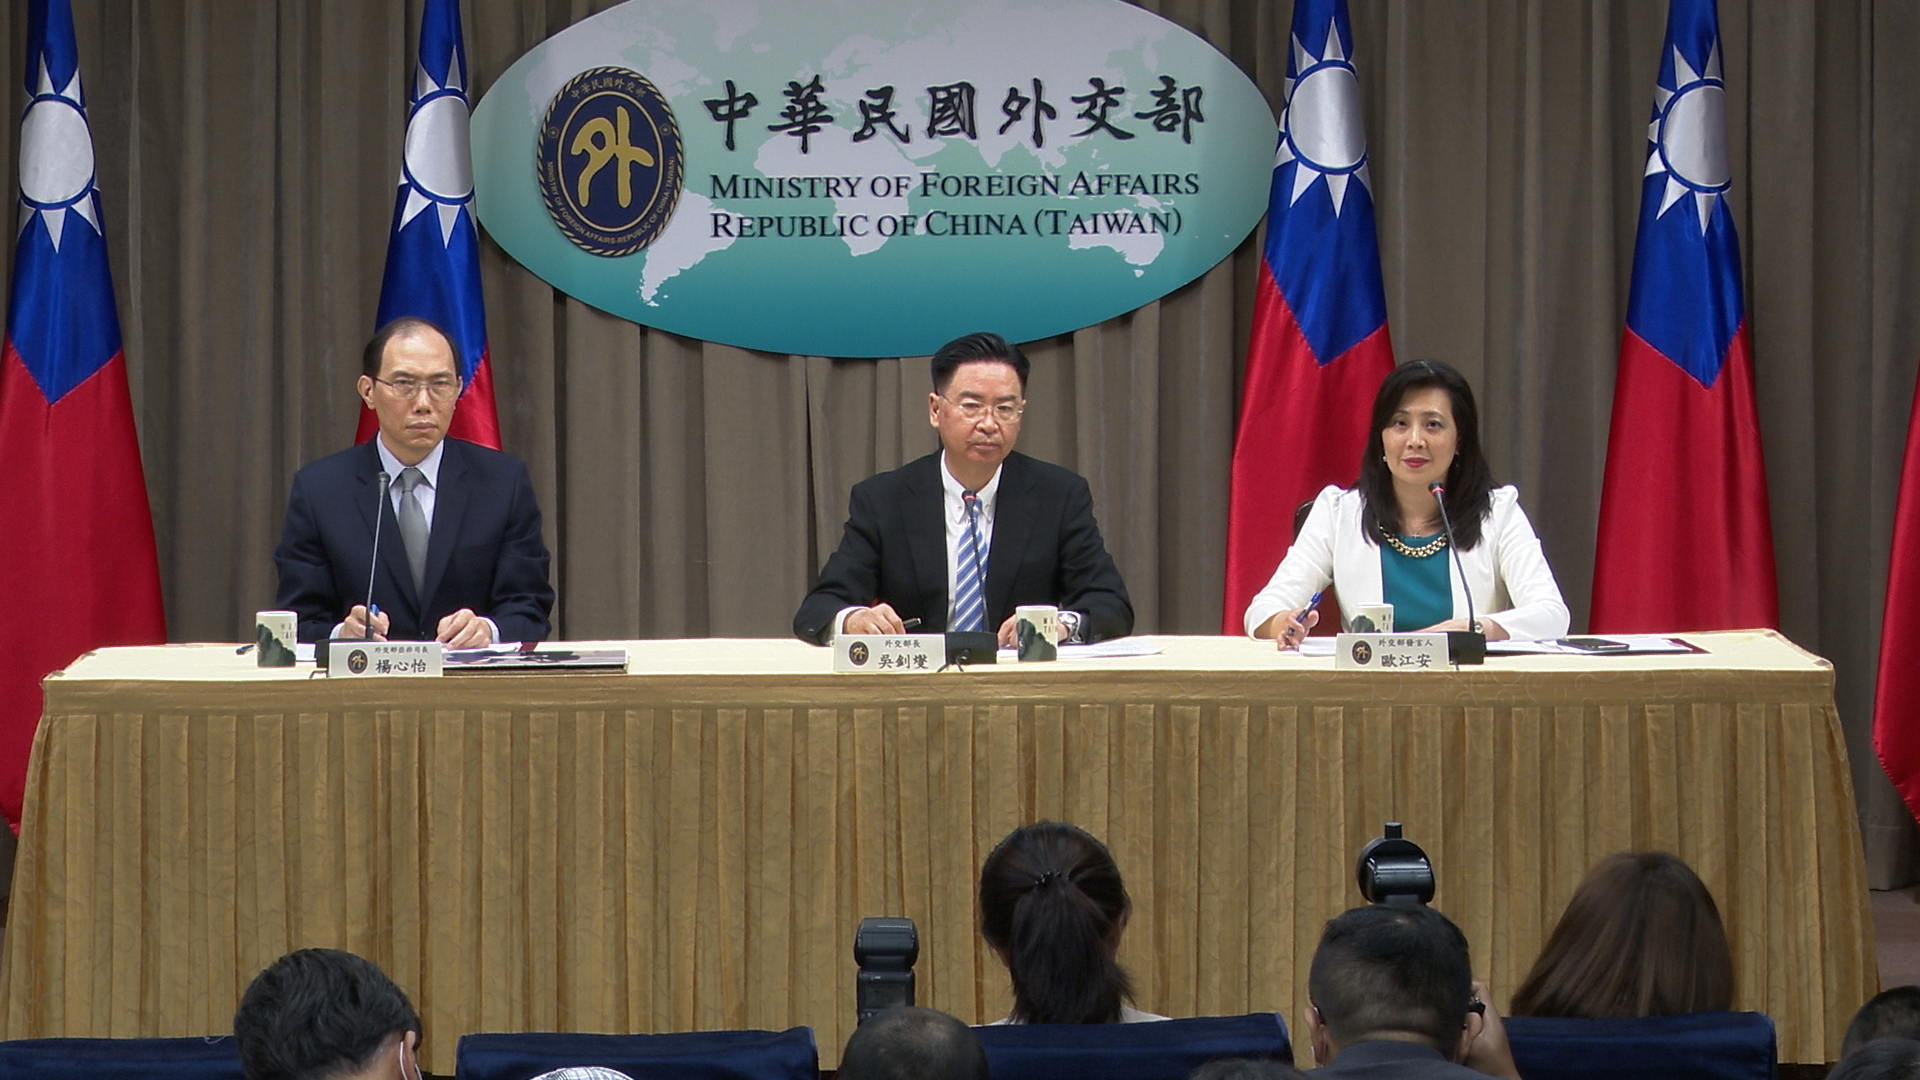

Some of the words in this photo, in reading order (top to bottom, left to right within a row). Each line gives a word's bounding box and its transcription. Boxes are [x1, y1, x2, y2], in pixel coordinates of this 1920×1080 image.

[571, 77, 647, 99] 中華民國外交部
[703, 75, 1206, 154] 中華民國外交部
[710, 173, 861, 199] MINISTRY
[870, 176, 911, 198] OF
[920, 172, 1061, 197] FOREIGN
[1068, 172, 1200, 196] AFFAIRS
[710, 212, 868, 238] REPUBLIC
[877, 215, 917, 237] OF
[925, 210, 1028, 237] CHINA
[1034, 208, 1183, 238] (TAIWAN)
[885, 640, 921, 648] 外交部長
[1378, 639, 1433, 648] 外交部發言人
[375, 658, 427, 674] 楊心怡
[1381, 653, 1432, 668] 歐江安
